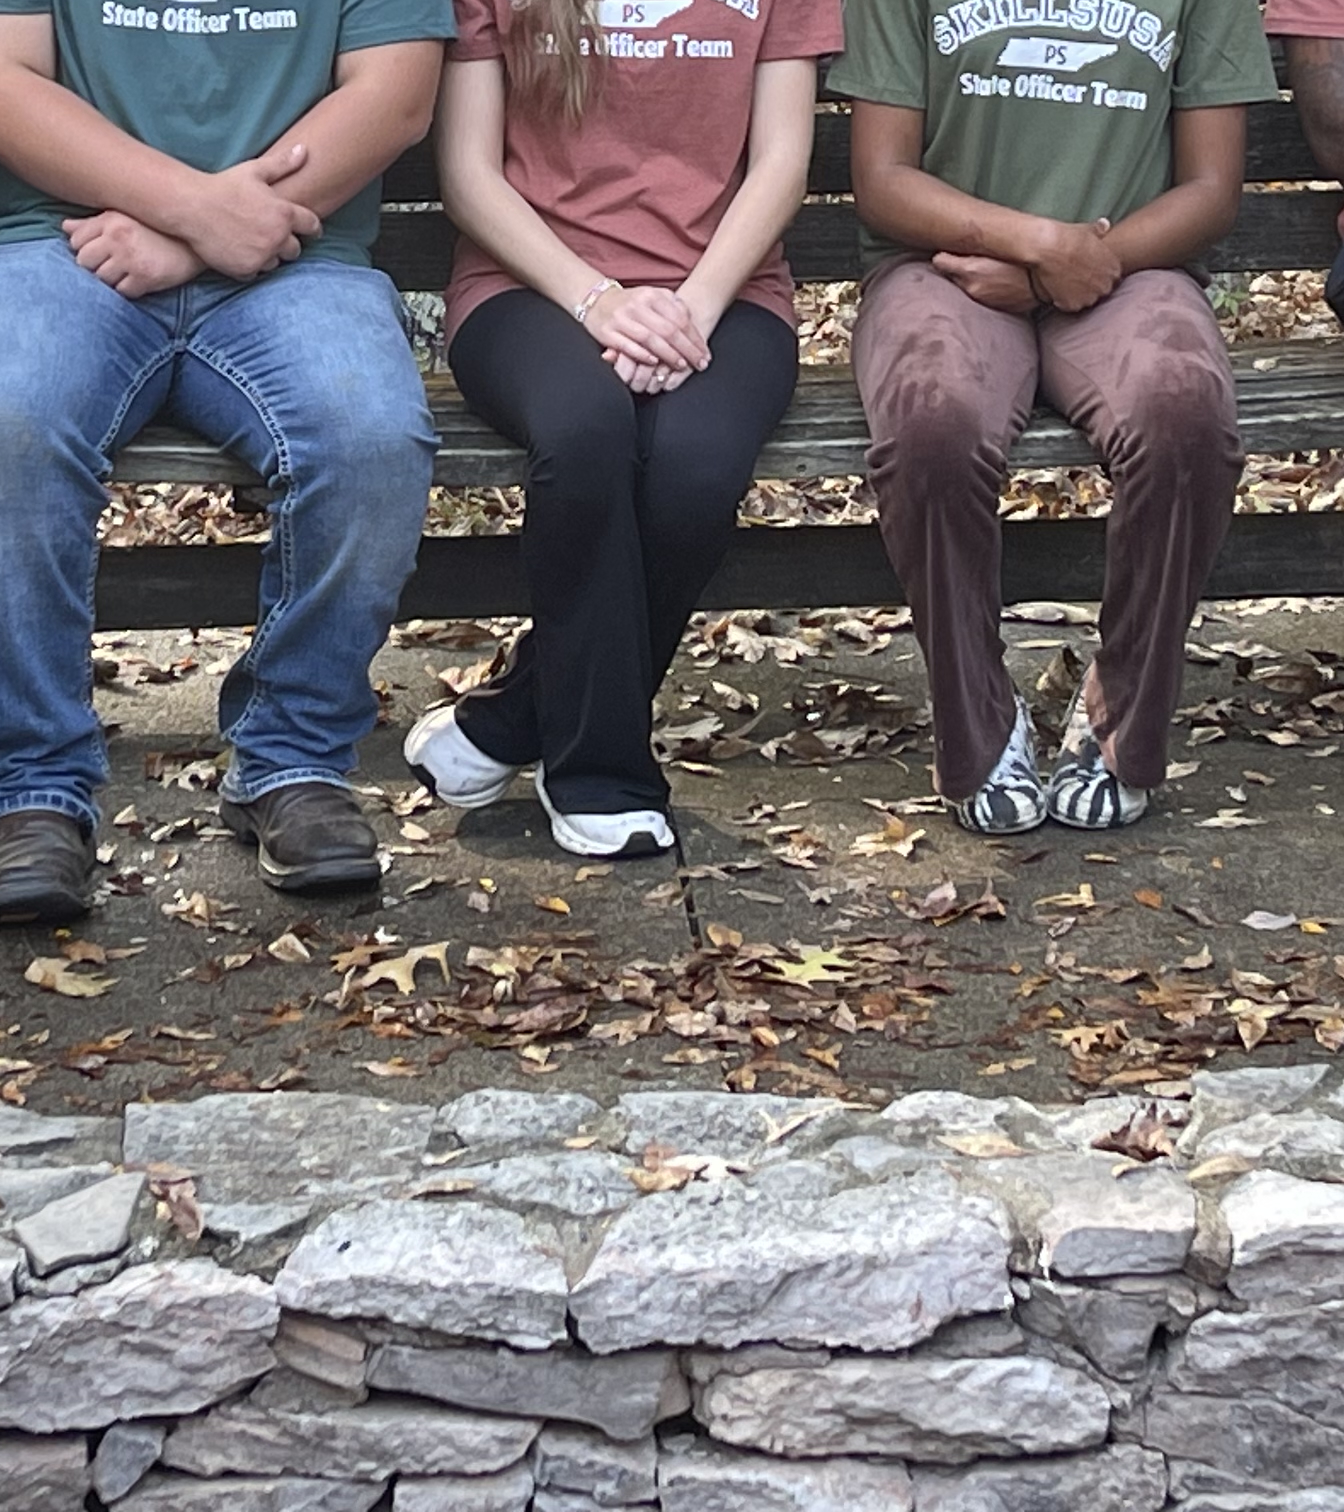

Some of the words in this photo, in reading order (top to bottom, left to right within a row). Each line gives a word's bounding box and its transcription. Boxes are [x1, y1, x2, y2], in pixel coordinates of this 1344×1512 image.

[102, 1, 158, 27] State
[162, 8, 230, 33] Officer
[234, 7, 297, 31] Team
[623, 5, 645, 22] PS
[672, 34, 733, 57] Team
[1045, 45, 1067, 64] PS
[960, 73, 1010, 96] State
[1014, 74, 1086, 103] Officer
[1091, 82, 1147, 110] Team
